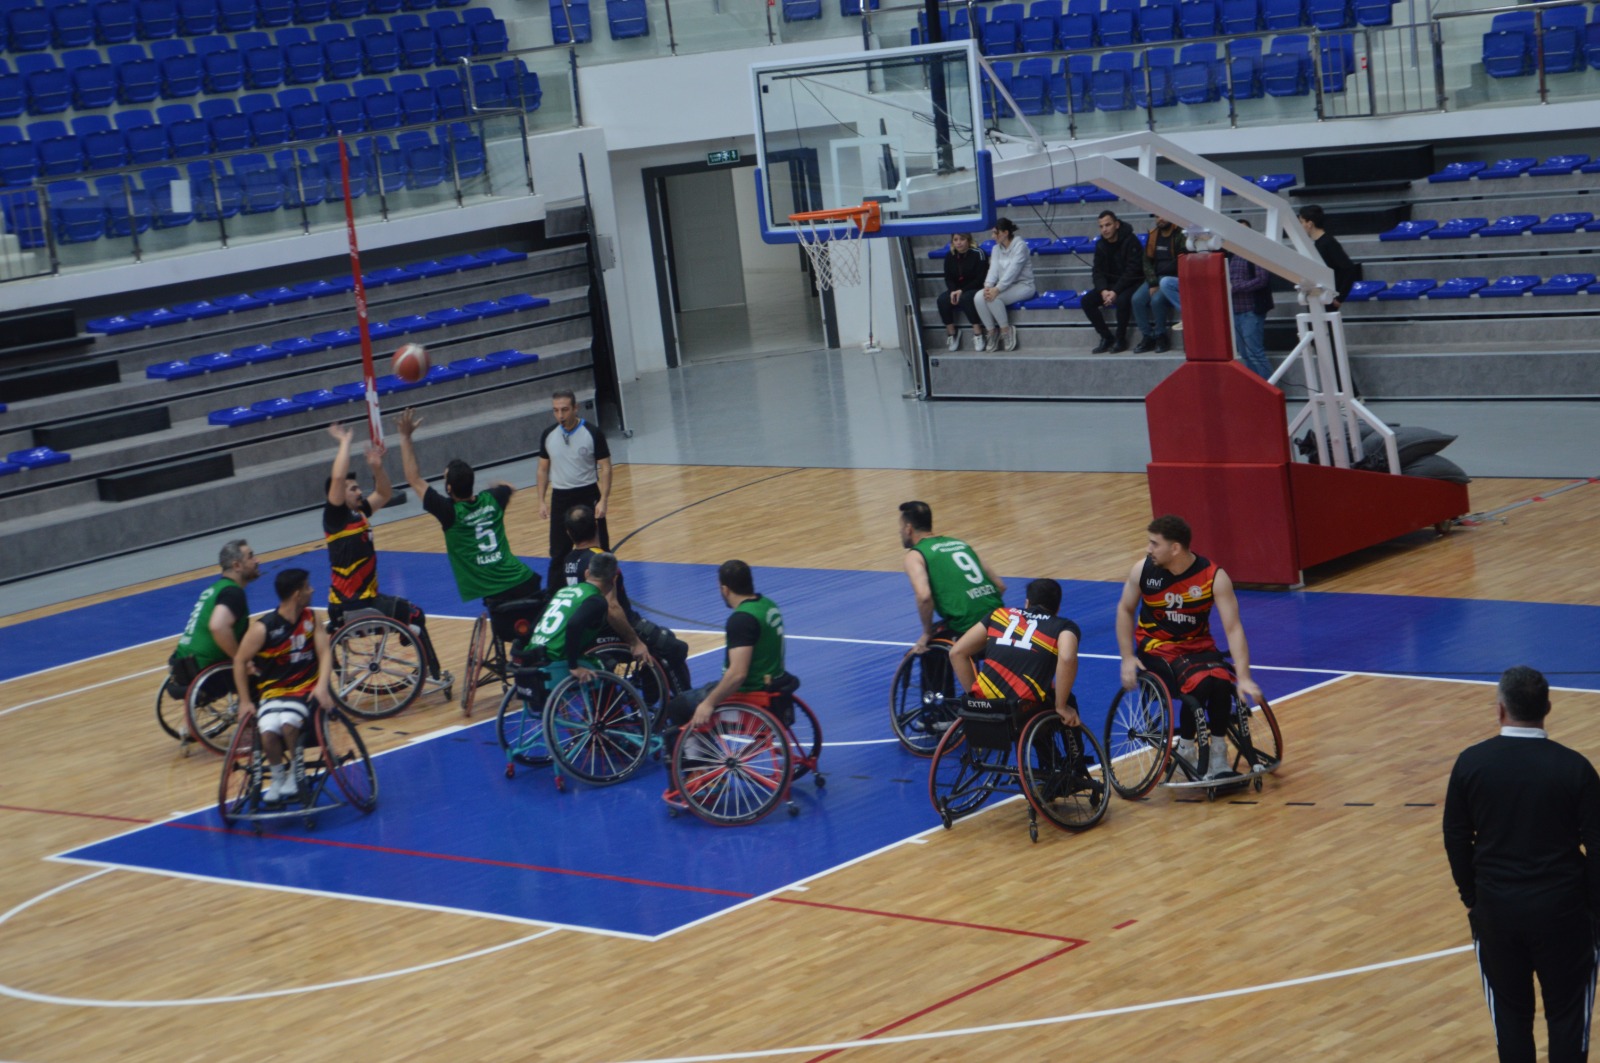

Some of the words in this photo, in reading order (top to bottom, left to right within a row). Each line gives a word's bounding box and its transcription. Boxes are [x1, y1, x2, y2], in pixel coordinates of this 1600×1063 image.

[475, 520, 498, 552] 5
[952, 551, 984, 584] 9
[1164, 592, 1184, 609] 99
[995, 614, 1038, 650] 11
[967, 699, 992, 709] EXTRA
[1196, 707, 1209, 747] EXTRA
